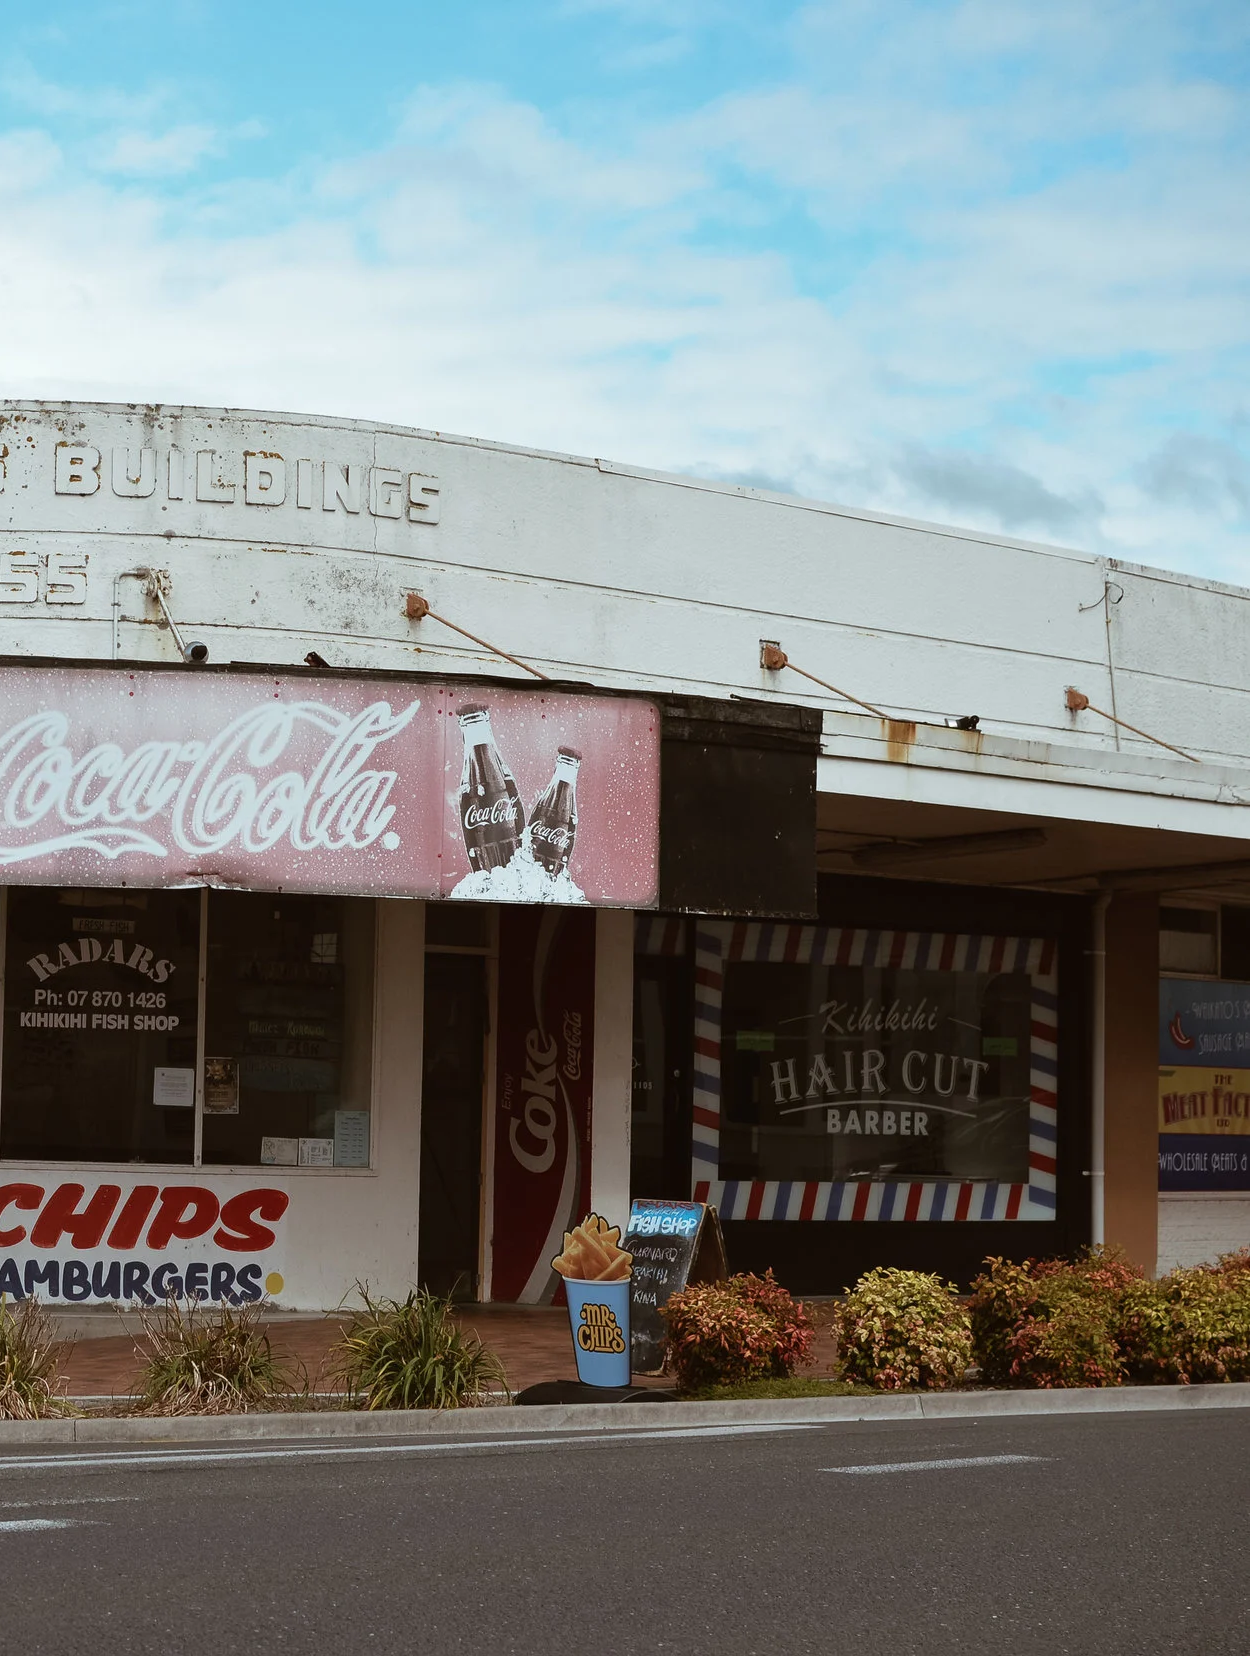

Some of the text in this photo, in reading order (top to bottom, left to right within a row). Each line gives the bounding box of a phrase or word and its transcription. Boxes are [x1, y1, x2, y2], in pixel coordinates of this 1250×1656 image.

[54, 441, 441, 525] BUILDINGS
[464, 796, 519, 830] Coca-Cola
[530, 820, 575, 849] Coca-Cola
[26, 937, 177, 983] RADARS
[34, 988, 167, 1008] Ph: 07 870 1426
[19, 1012, 180, 1031] KIHIKIHI FISH SHOP
[819, 997, 938, 1035] Kihikihi
[502, 1072, 515, 1110] Enjoy
[769, 1049, 989, 1104] HAIR CUT
[509, 1027, 559, 1174] Coke
[1162, 1090, 1207, 1126] MEAT
[826, 1109, 930, 1136] BARBER
[1158, 1152, 1208, 1171] WHOLESALE
[627, 1213, 698, 1234] FISH SHOP
[633, 1289, 658, 1306] KINA
[577, 1324, 626, 1354] CHIPS
